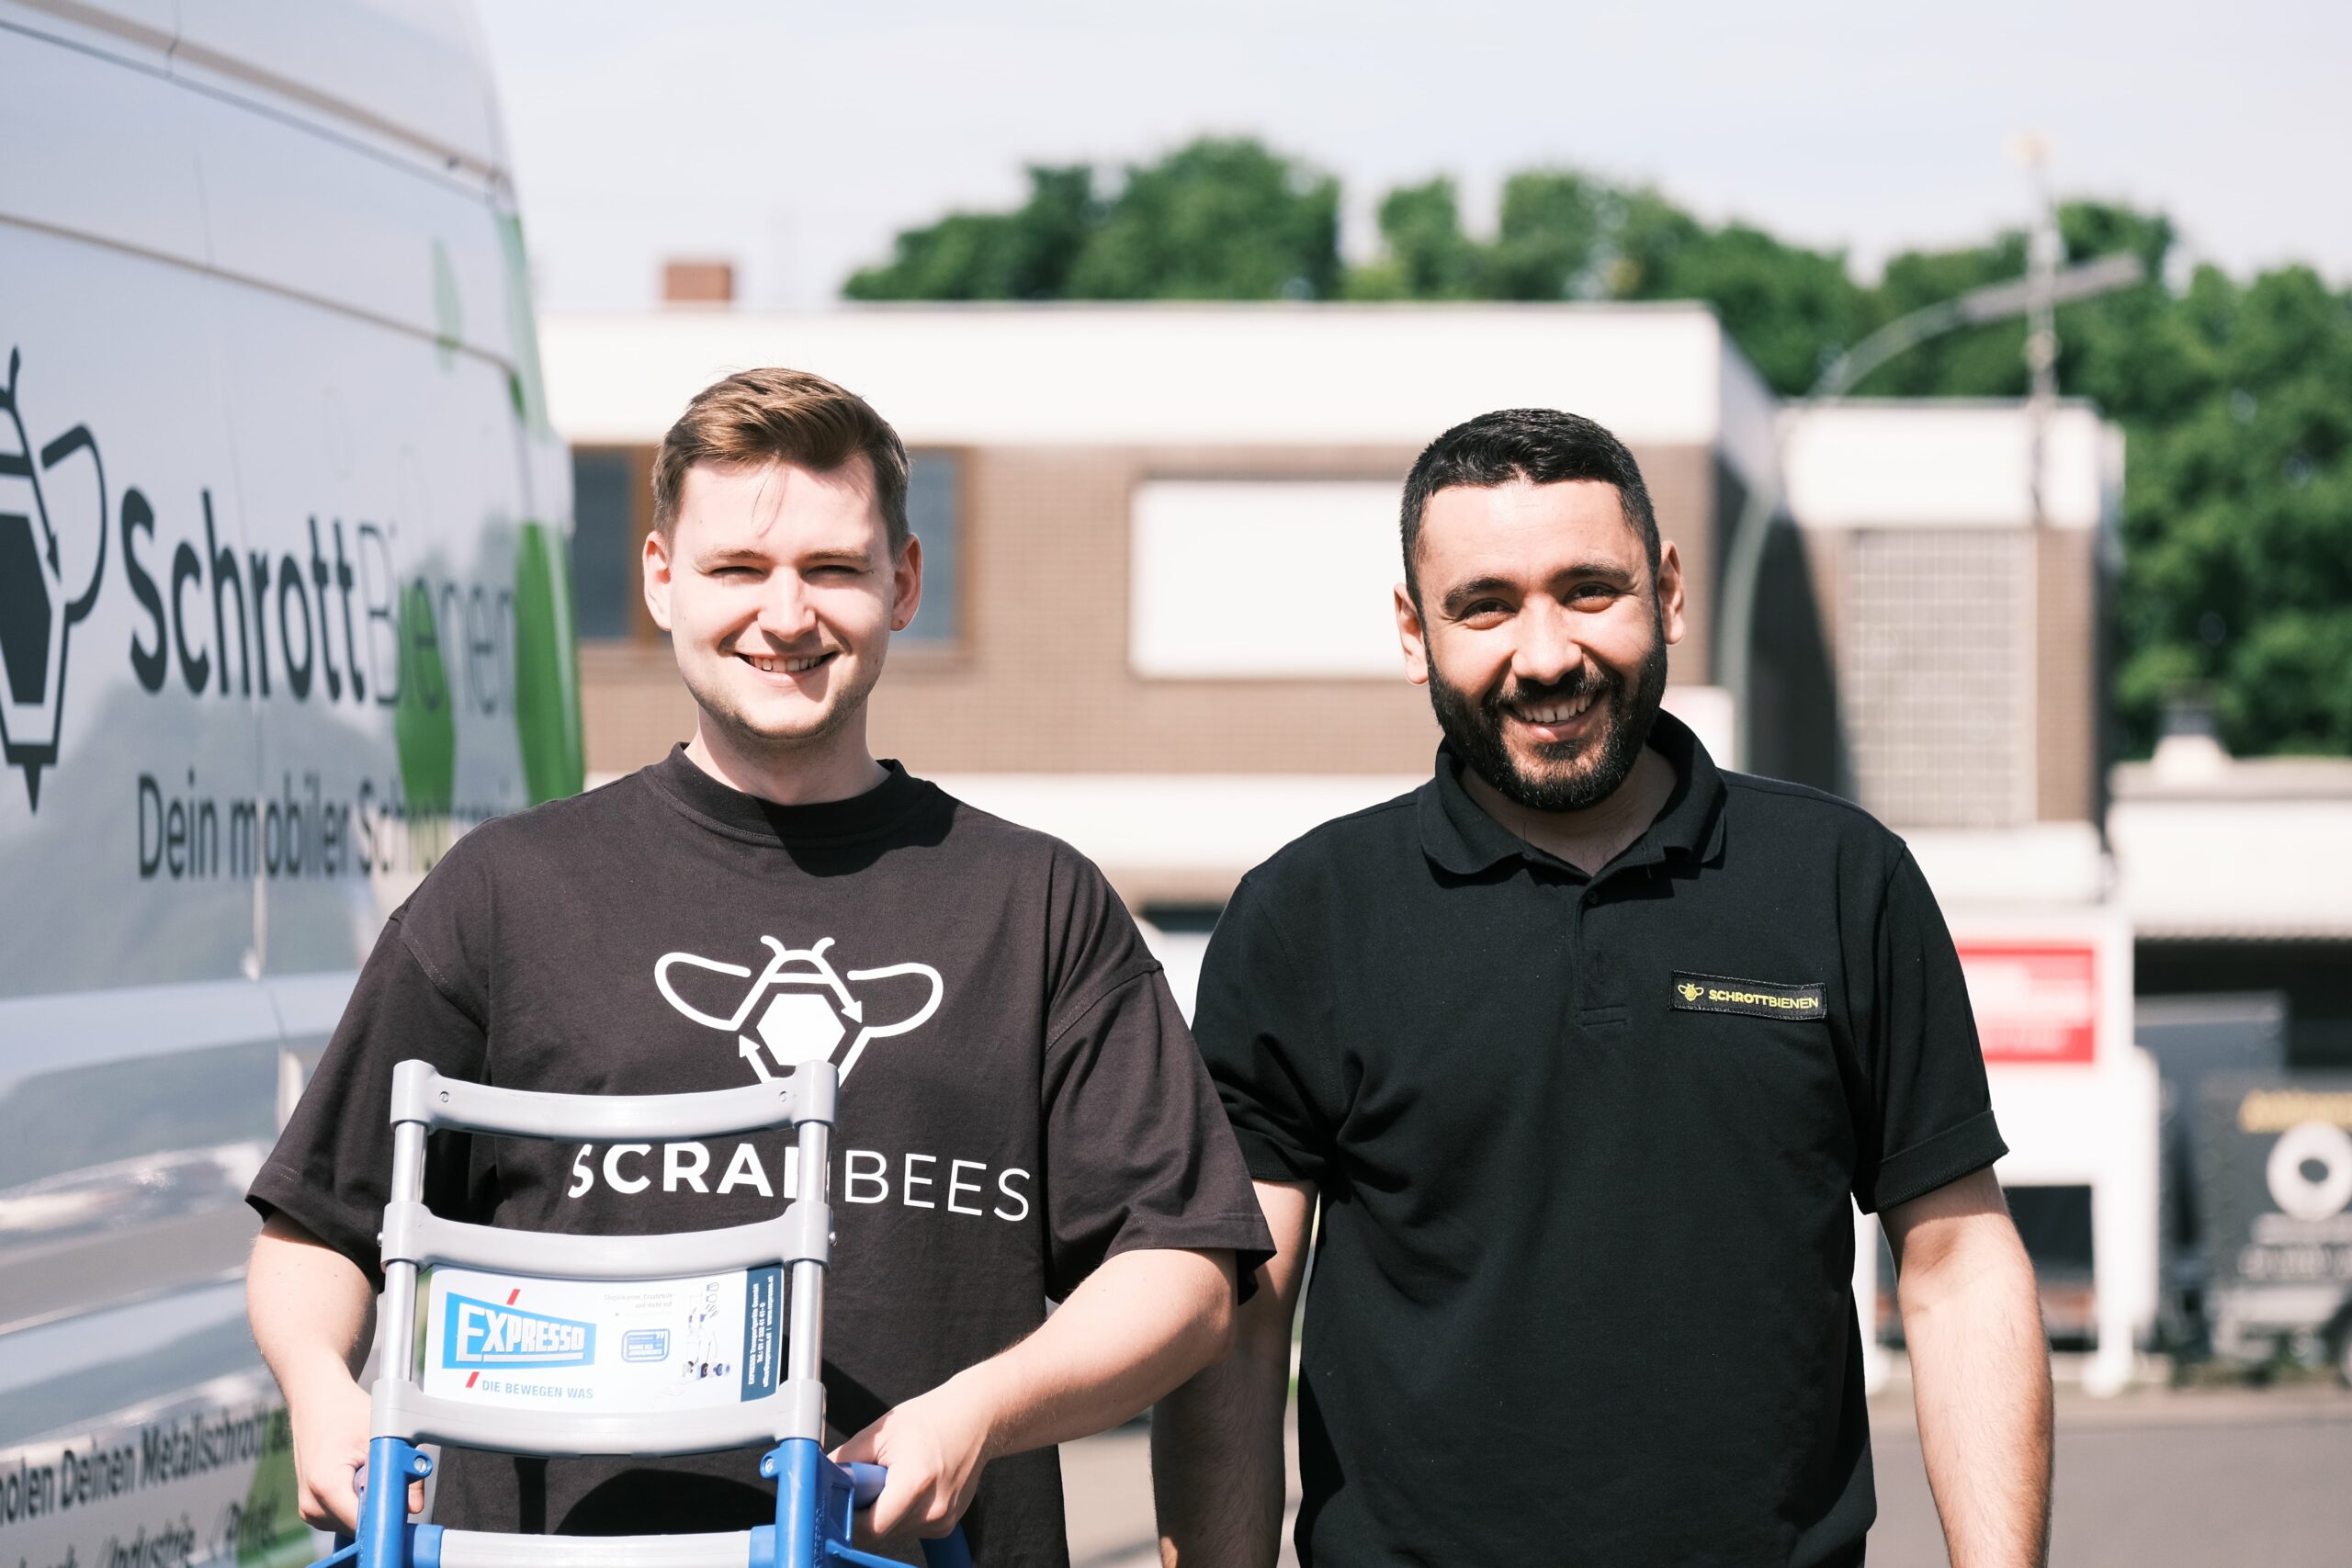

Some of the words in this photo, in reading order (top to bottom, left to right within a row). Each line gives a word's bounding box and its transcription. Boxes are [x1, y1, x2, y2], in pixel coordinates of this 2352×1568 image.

[137, 770, 219, 880] Dein
[229, 768, 353, 879] mobiler
[1708, 988, 1819, 1010] SCHROTTBIENEN
[456, 1302, 585, 1363] EXPRESSO
[481, 1380, 502, 1393] DIE
[504, 1382, 563, 1398] BEWEGEN
[566, 1384, 594, 1400] WAS
[61, 1442, 134, 1508] Deinen
